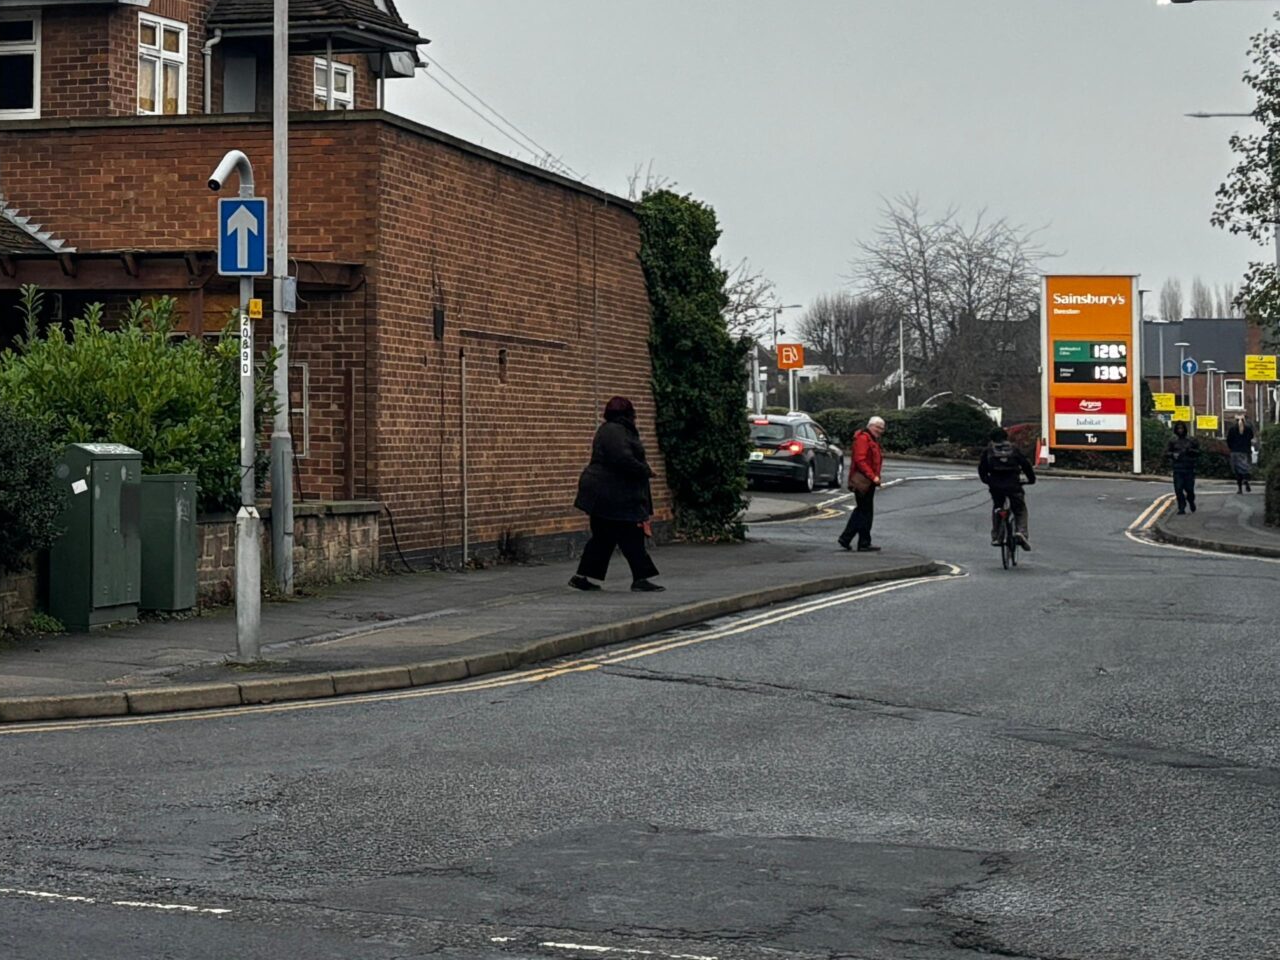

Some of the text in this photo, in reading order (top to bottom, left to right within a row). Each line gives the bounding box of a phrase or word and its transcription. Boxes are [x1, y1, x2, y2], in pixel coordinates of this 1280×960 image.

[1053, 293, 1126, 307] Sainsbury's
[241, 316, 249, 374] 20890
[1085, 433, 1097, 443] Tu
